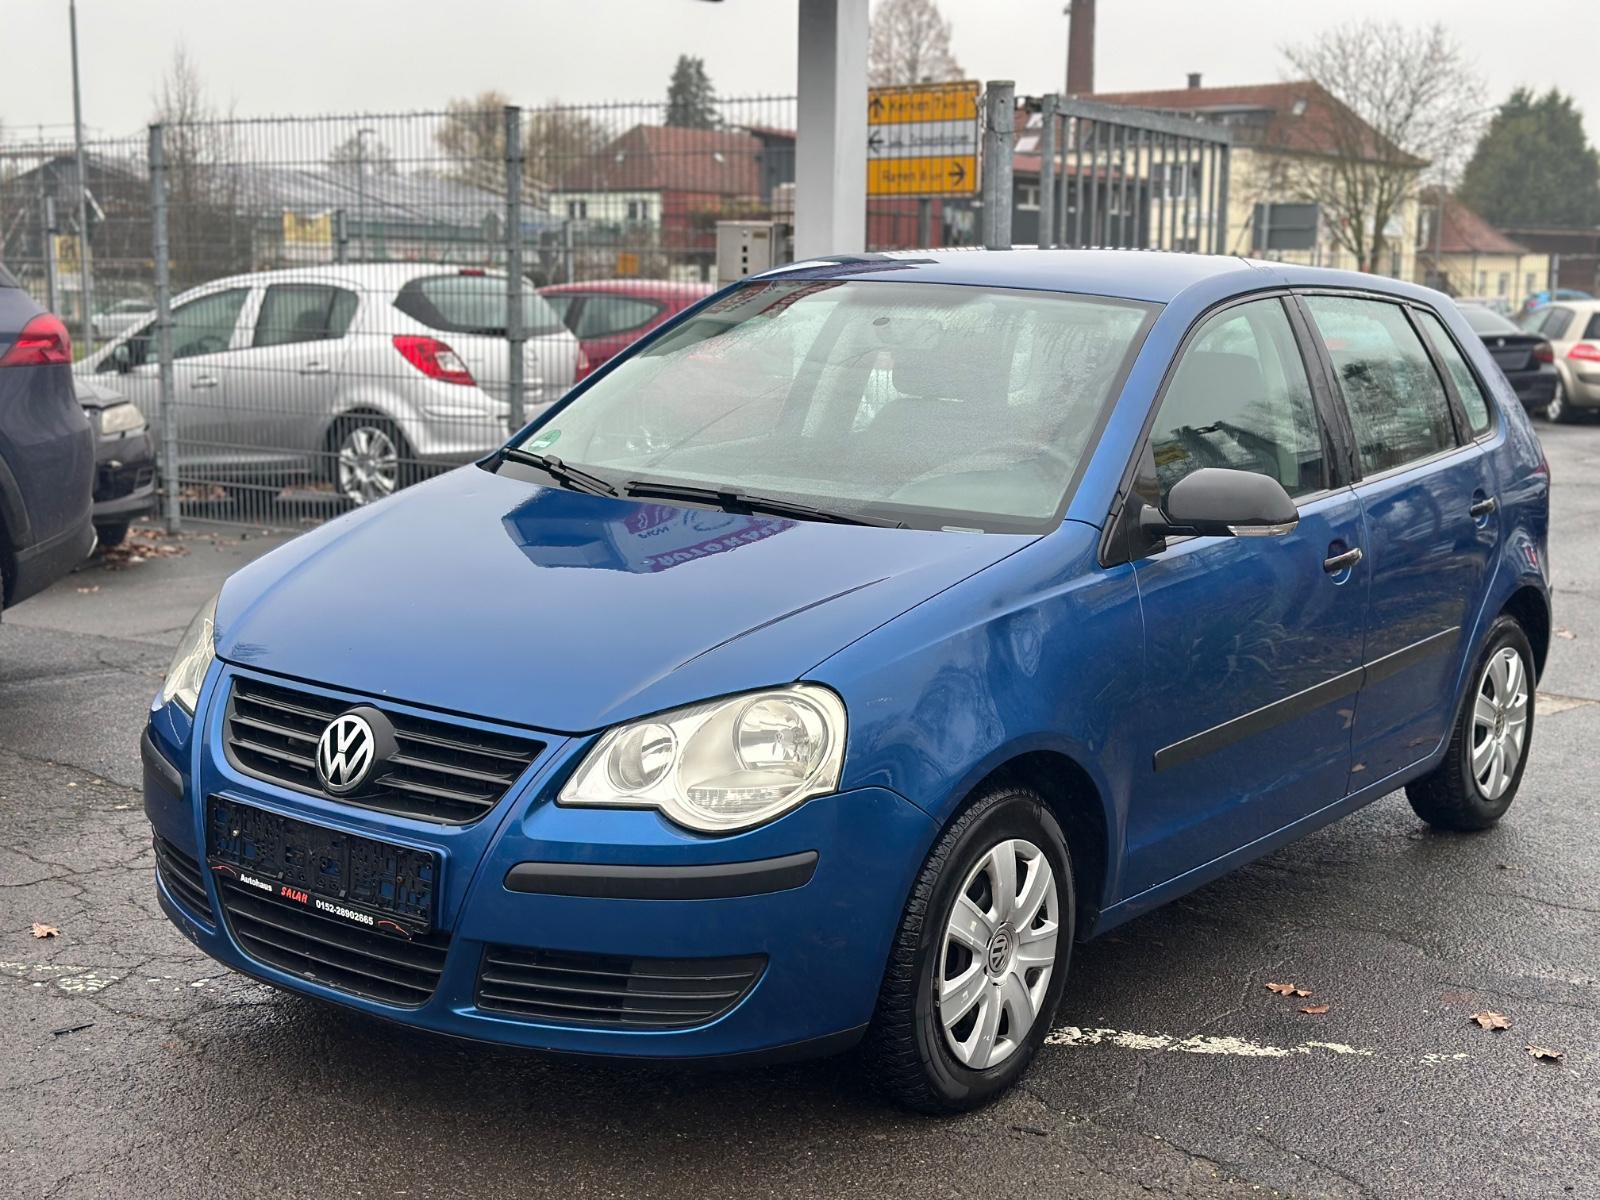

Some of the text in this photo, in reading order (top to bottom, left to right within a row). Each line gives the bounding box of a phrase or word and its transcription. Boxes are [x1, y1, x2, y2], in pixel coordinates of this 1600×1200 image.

[318, 714, 374, 791] VW
[240, 874, 272, 892] Autohaus
[315, 899, 374, 926] 0152-28902665
